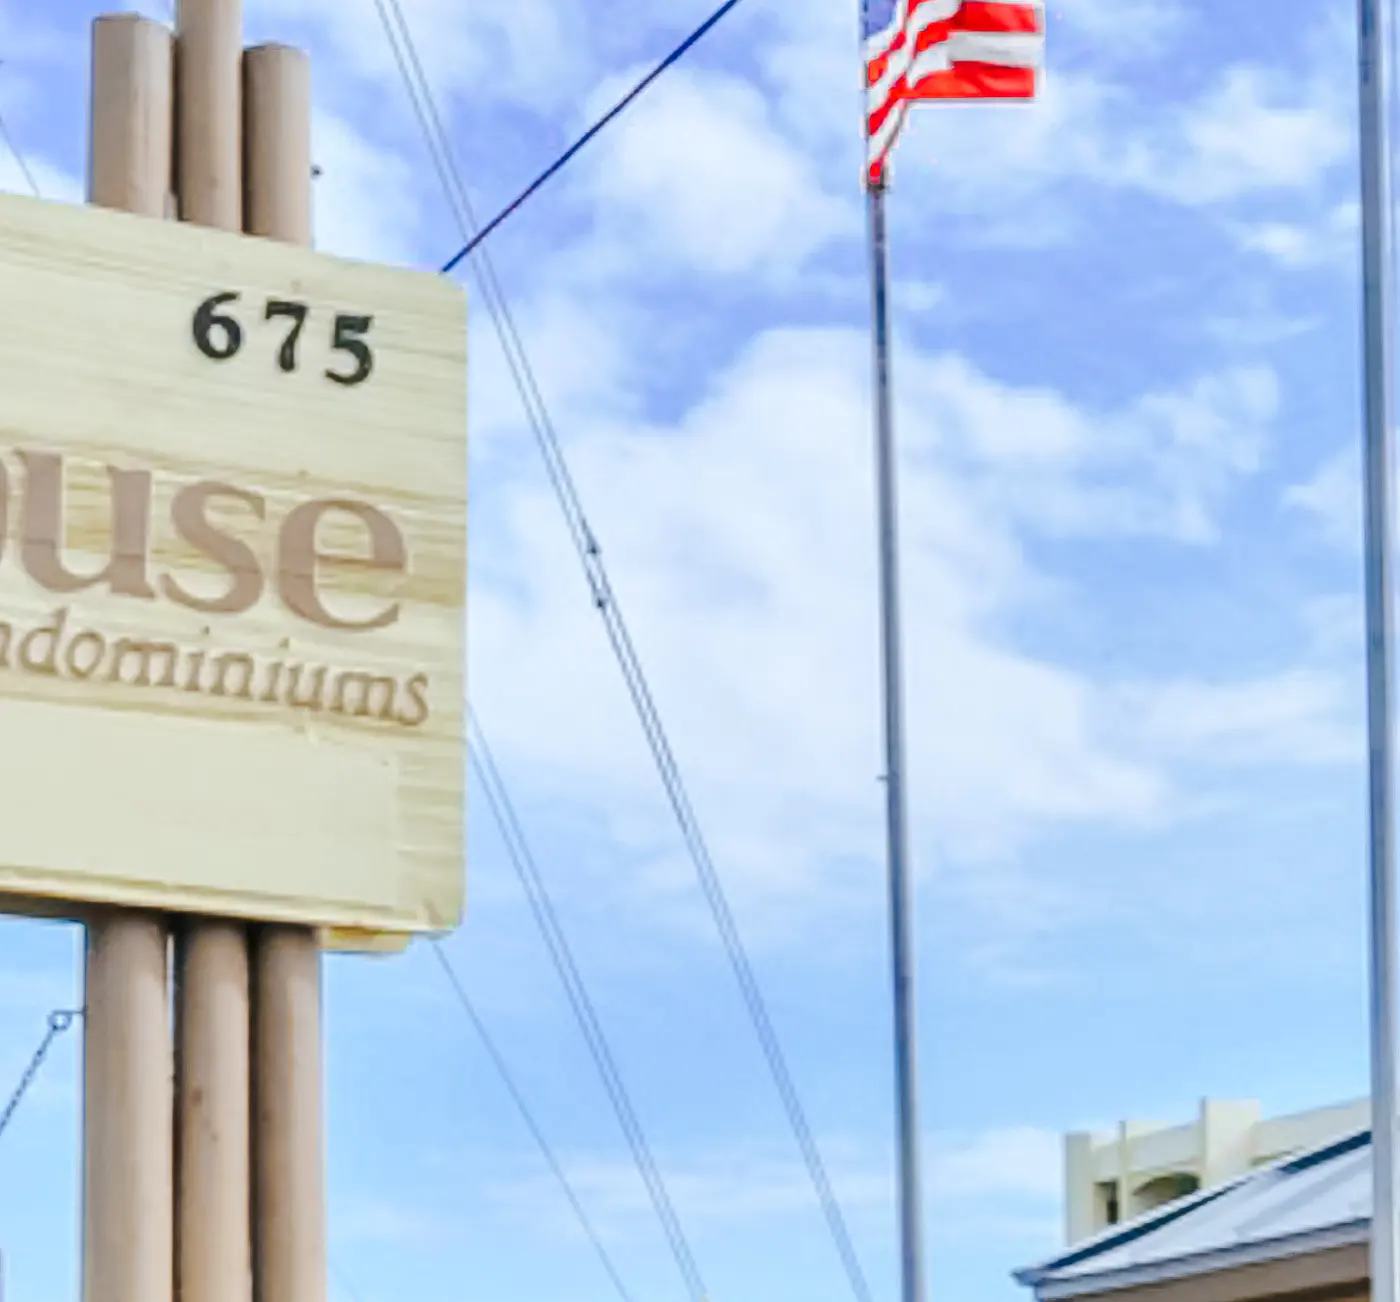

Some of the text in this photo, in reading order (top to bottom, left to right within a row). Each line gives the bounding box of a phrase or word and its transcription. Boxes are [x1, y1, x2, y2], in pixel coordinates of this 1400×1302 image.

[192, 290, 374, 386] 675
[0, 447, 408, 633] use
[0, 607, 430, 727] dominiums
